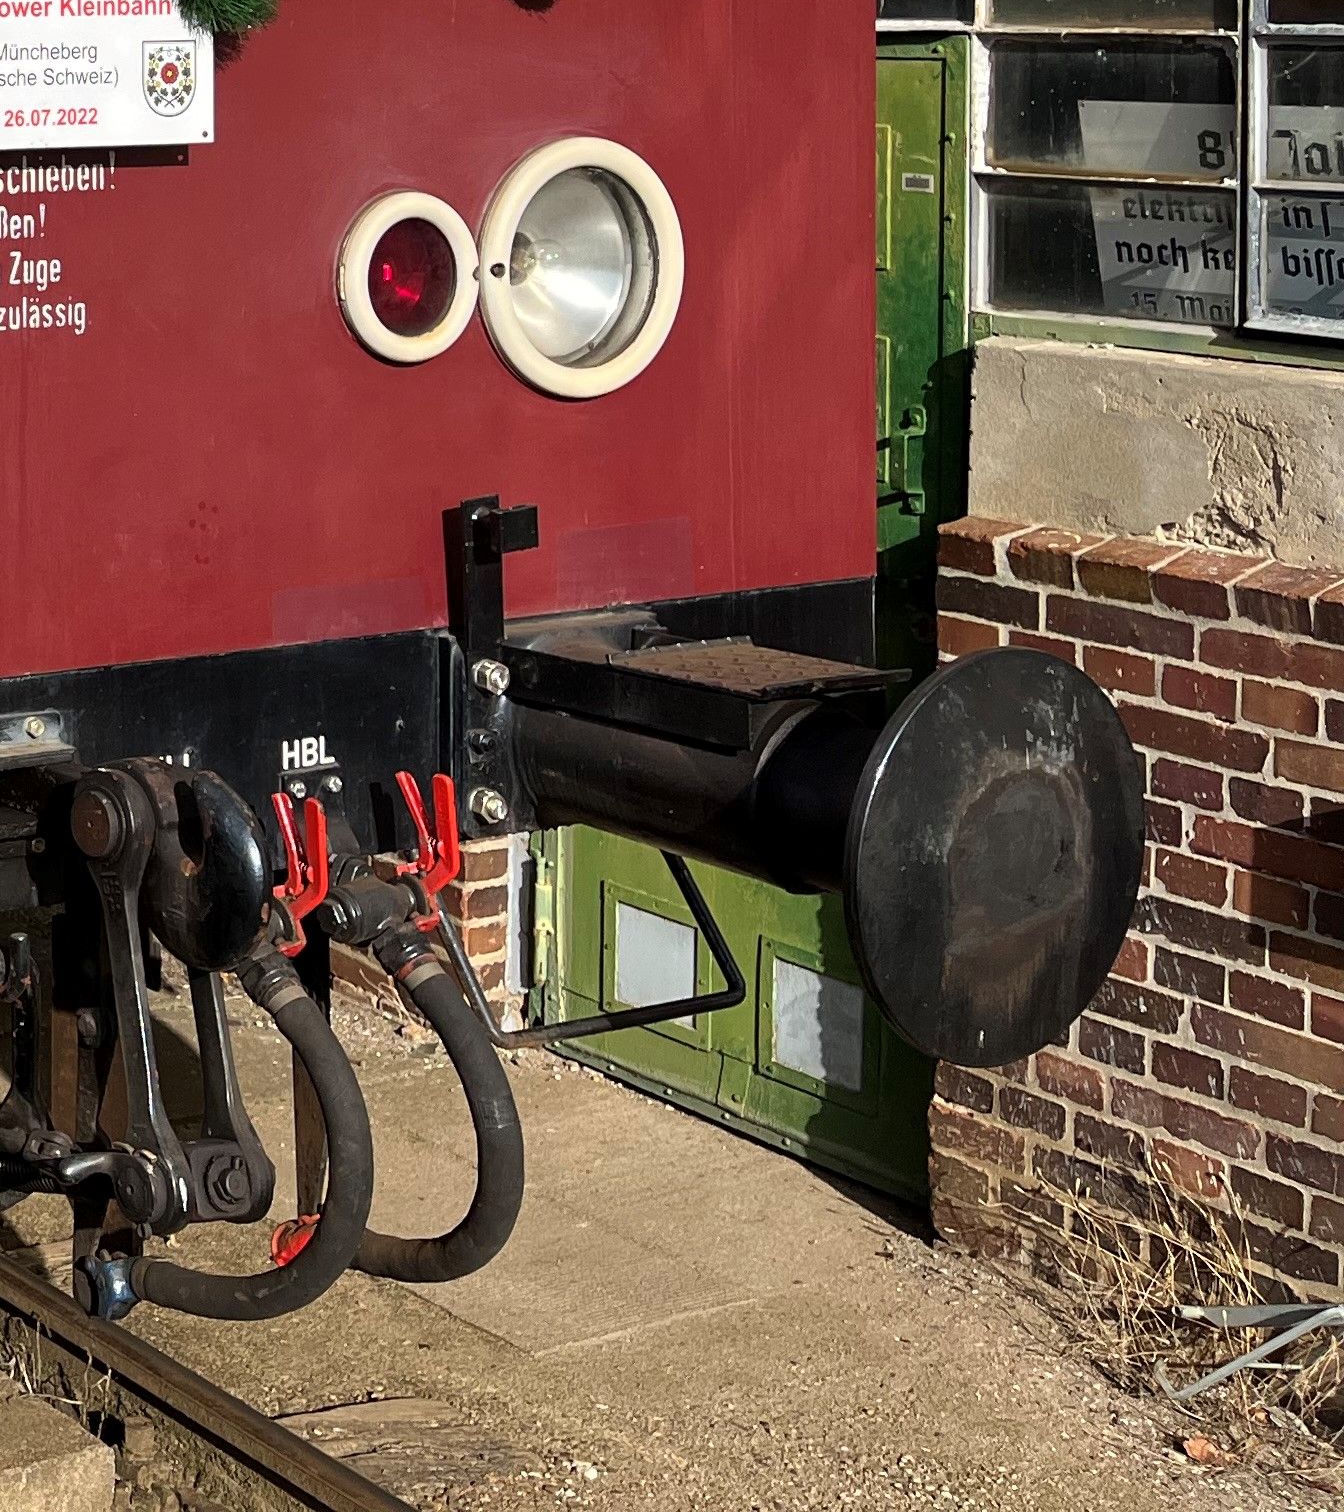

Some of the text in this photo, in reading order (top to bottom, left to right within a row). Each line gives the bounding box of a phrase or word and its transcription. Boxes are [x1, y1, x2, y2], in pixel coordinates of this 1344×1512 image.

[43, 66, 119, 91] Schweiz)
[4, 107, 98, 128] 26.07.2022
[9, 250, 61, 292] Zuge
[1116, 237, 1190, 274] noch
[282, 735, 336, 771] HBL
